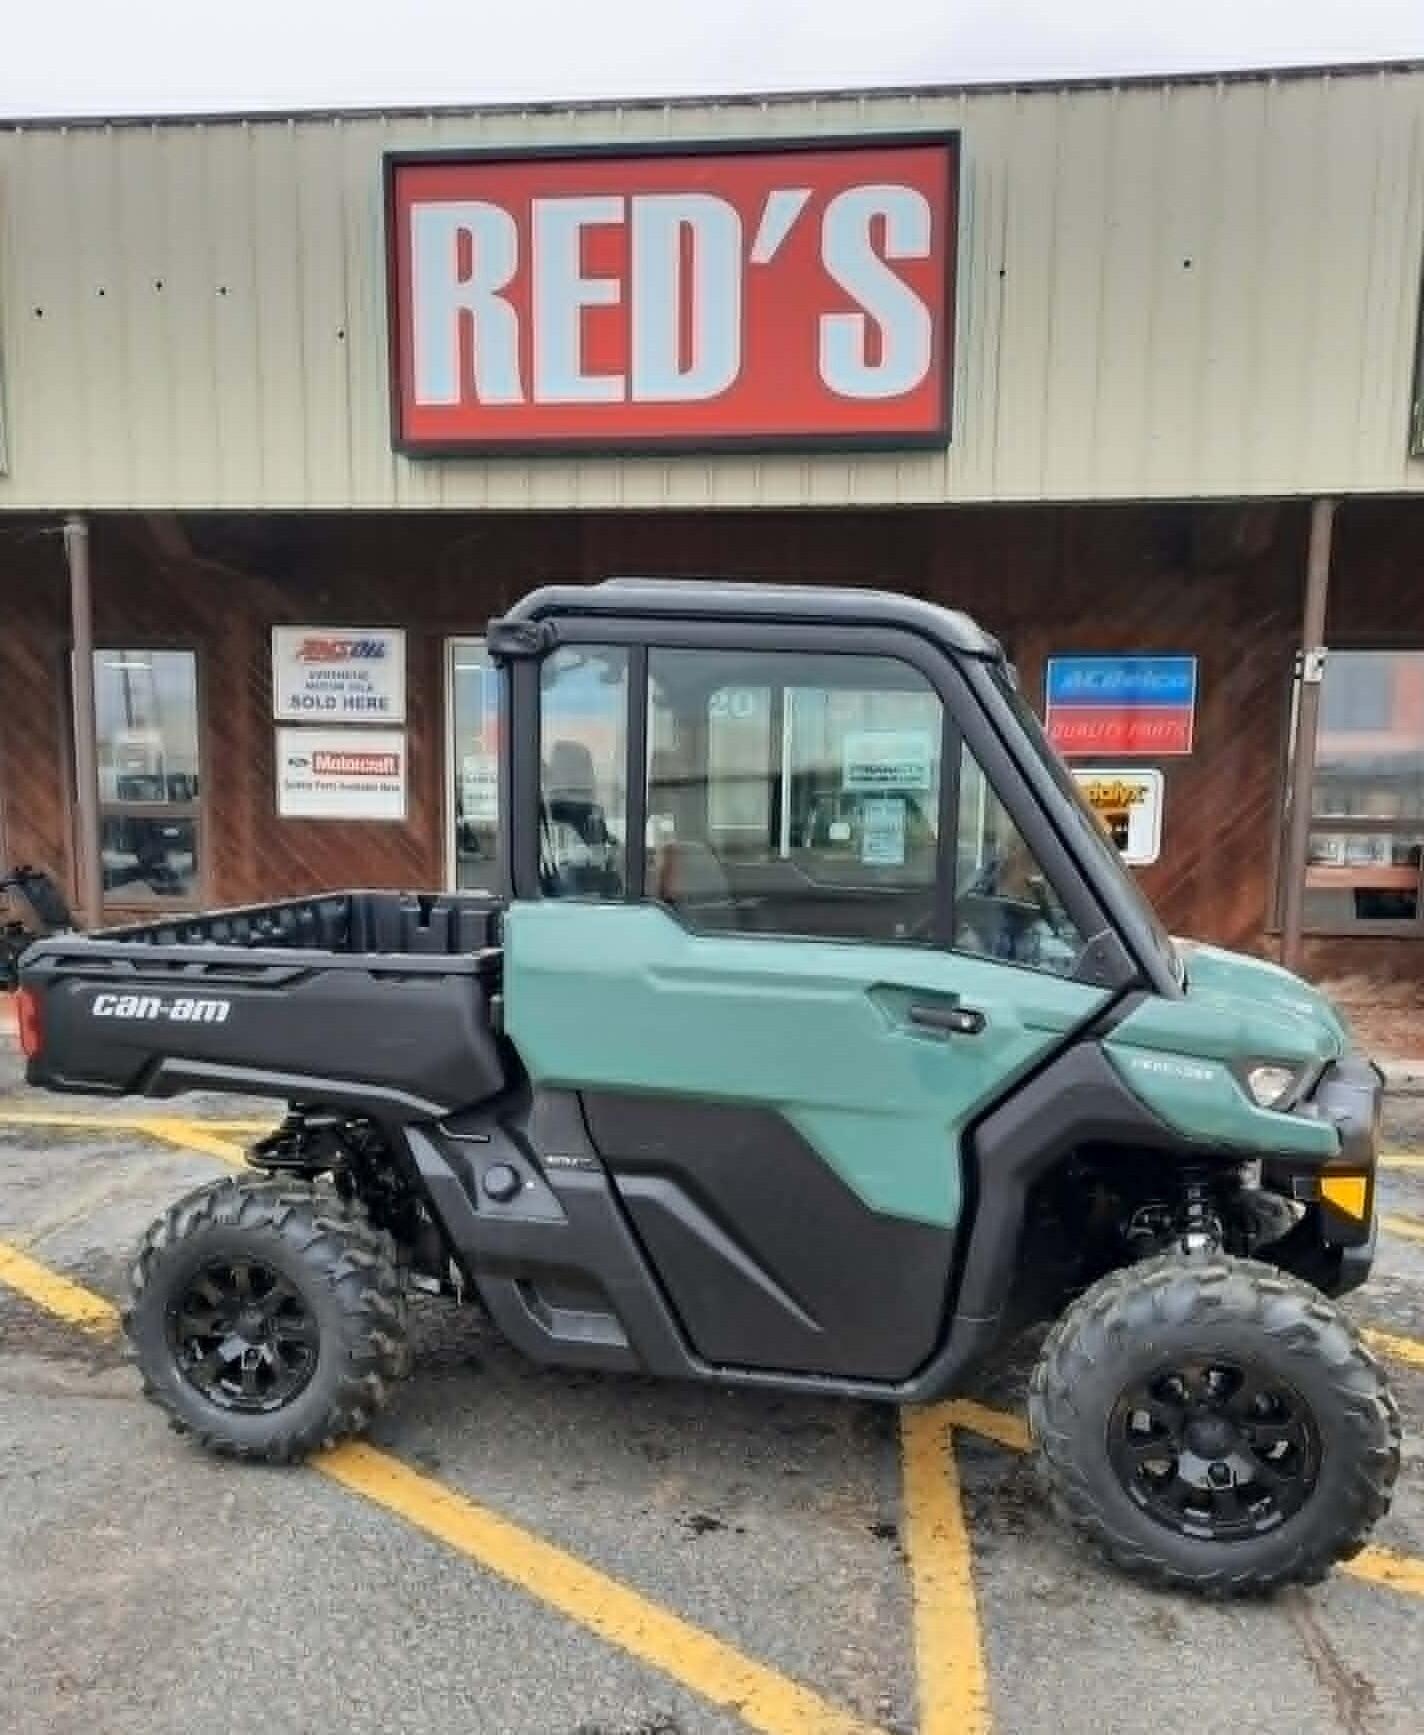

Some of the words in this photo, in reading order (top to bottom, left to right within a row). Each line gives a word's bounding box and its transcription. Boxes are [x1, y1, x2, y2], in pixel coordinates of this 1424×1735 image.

[410, 183, 932, 405] RED'S
[290, 694, 337, 711] SOLD
[343, 694, 391, 711] HERE
